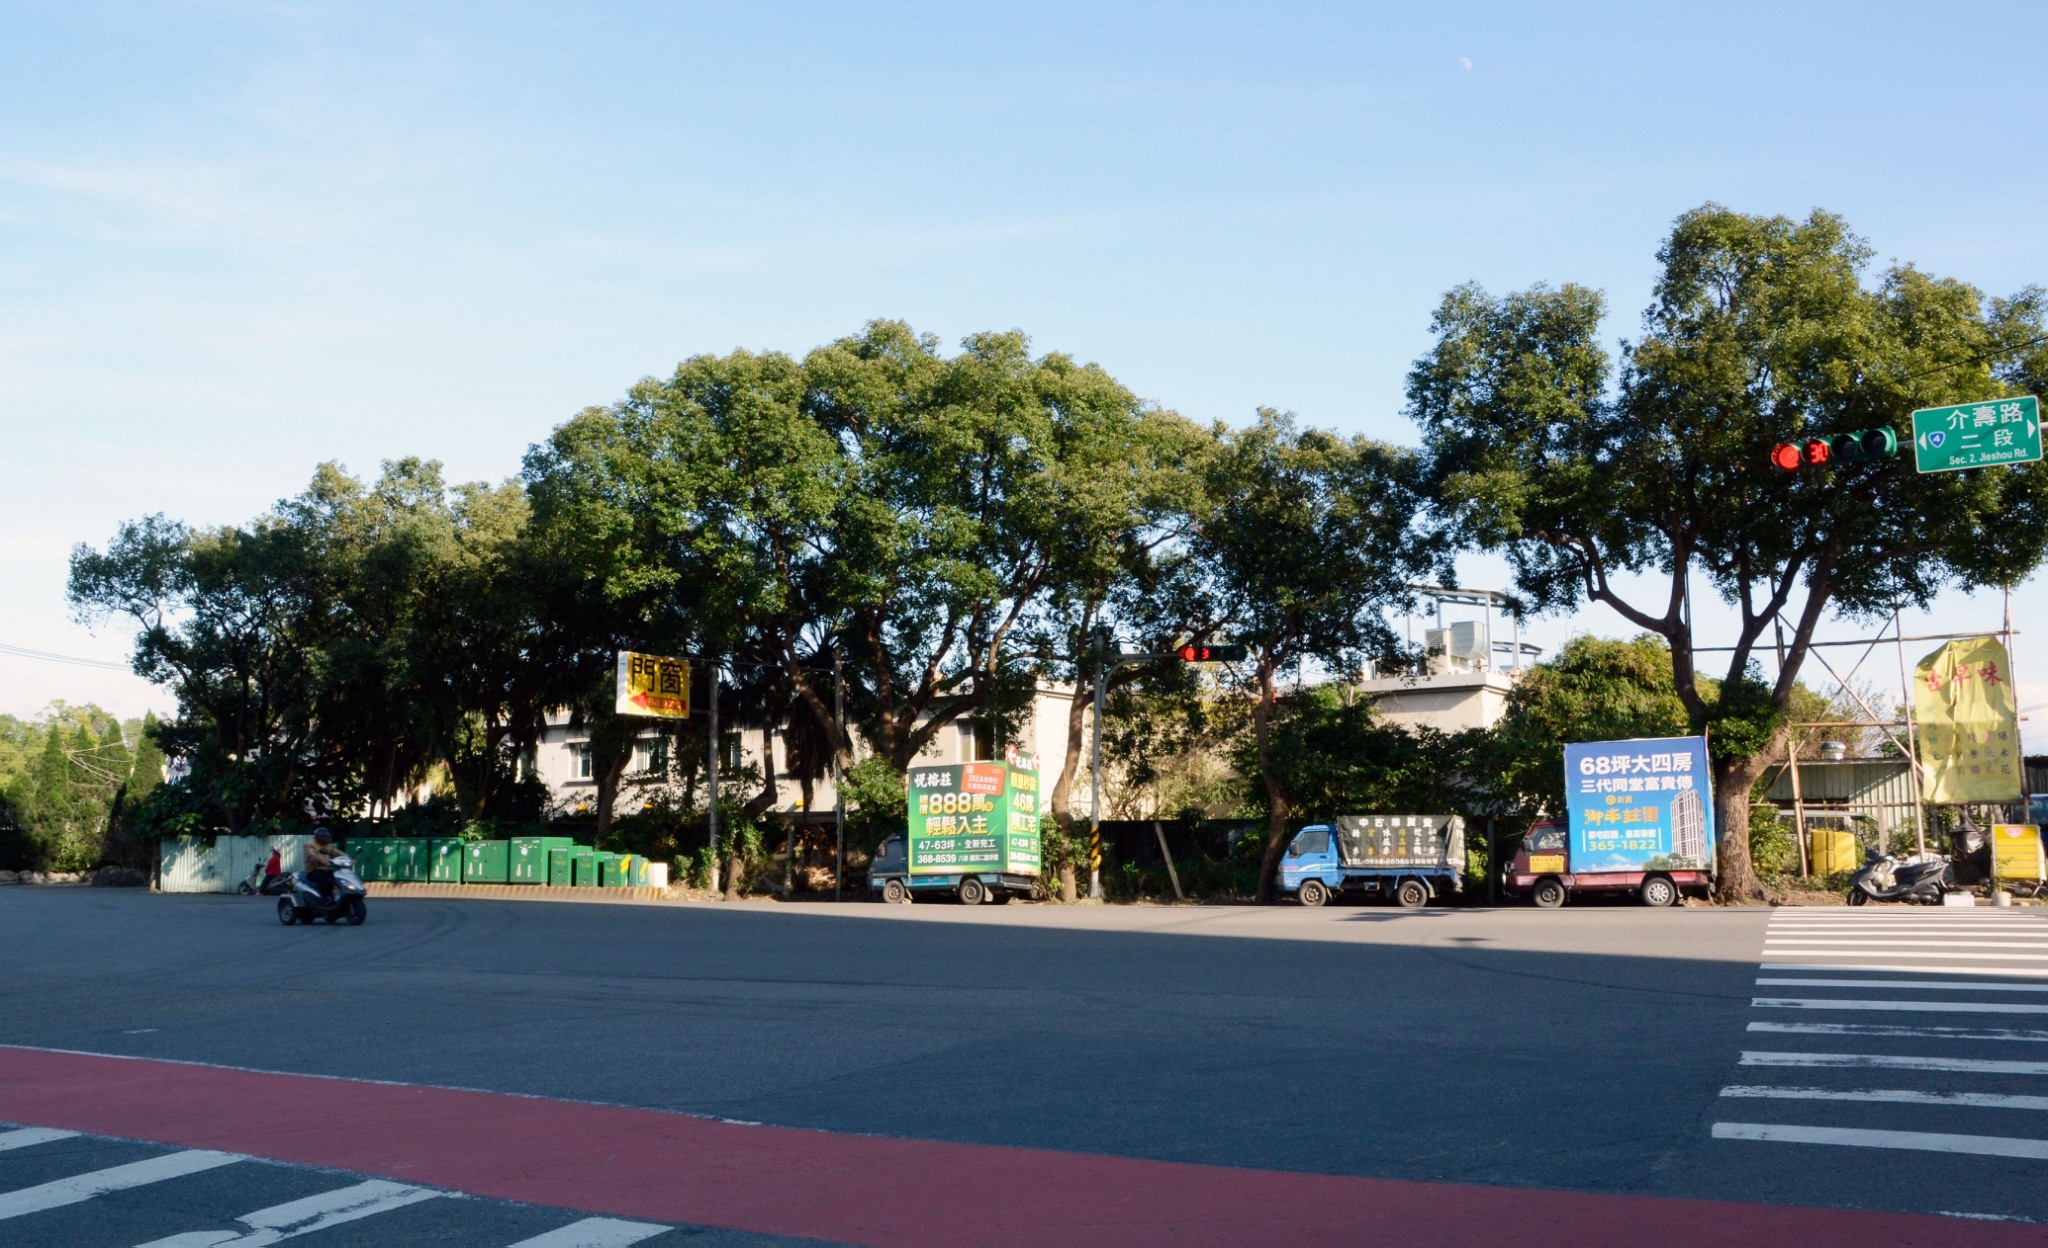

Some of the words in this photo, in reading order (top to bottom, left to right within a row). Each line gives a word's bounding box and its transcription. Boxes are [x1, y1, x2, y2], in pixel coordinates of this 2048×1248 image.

[1946, 401, 2024, 430] 介壽路
[1932, 434, 1941, 444] 4
[1960, 428, 2014, 450] 二段
[1949, 455, 1968, 465] Sec.
[1979, 449, 2013, 462] Jieshou
[2014, 447, 2029, 458] Rd.
[632, 656, 682, 696] 門窗
[1924, 660, 2004, 692] 古早味
[1580, 752, 1693, 775] 68坪大四房
[926, 815, 988, 837] 輕鬆入主
[1588, 839, 1656, 851] 365-1822
[917, 853, 957, 864] 368-8539
